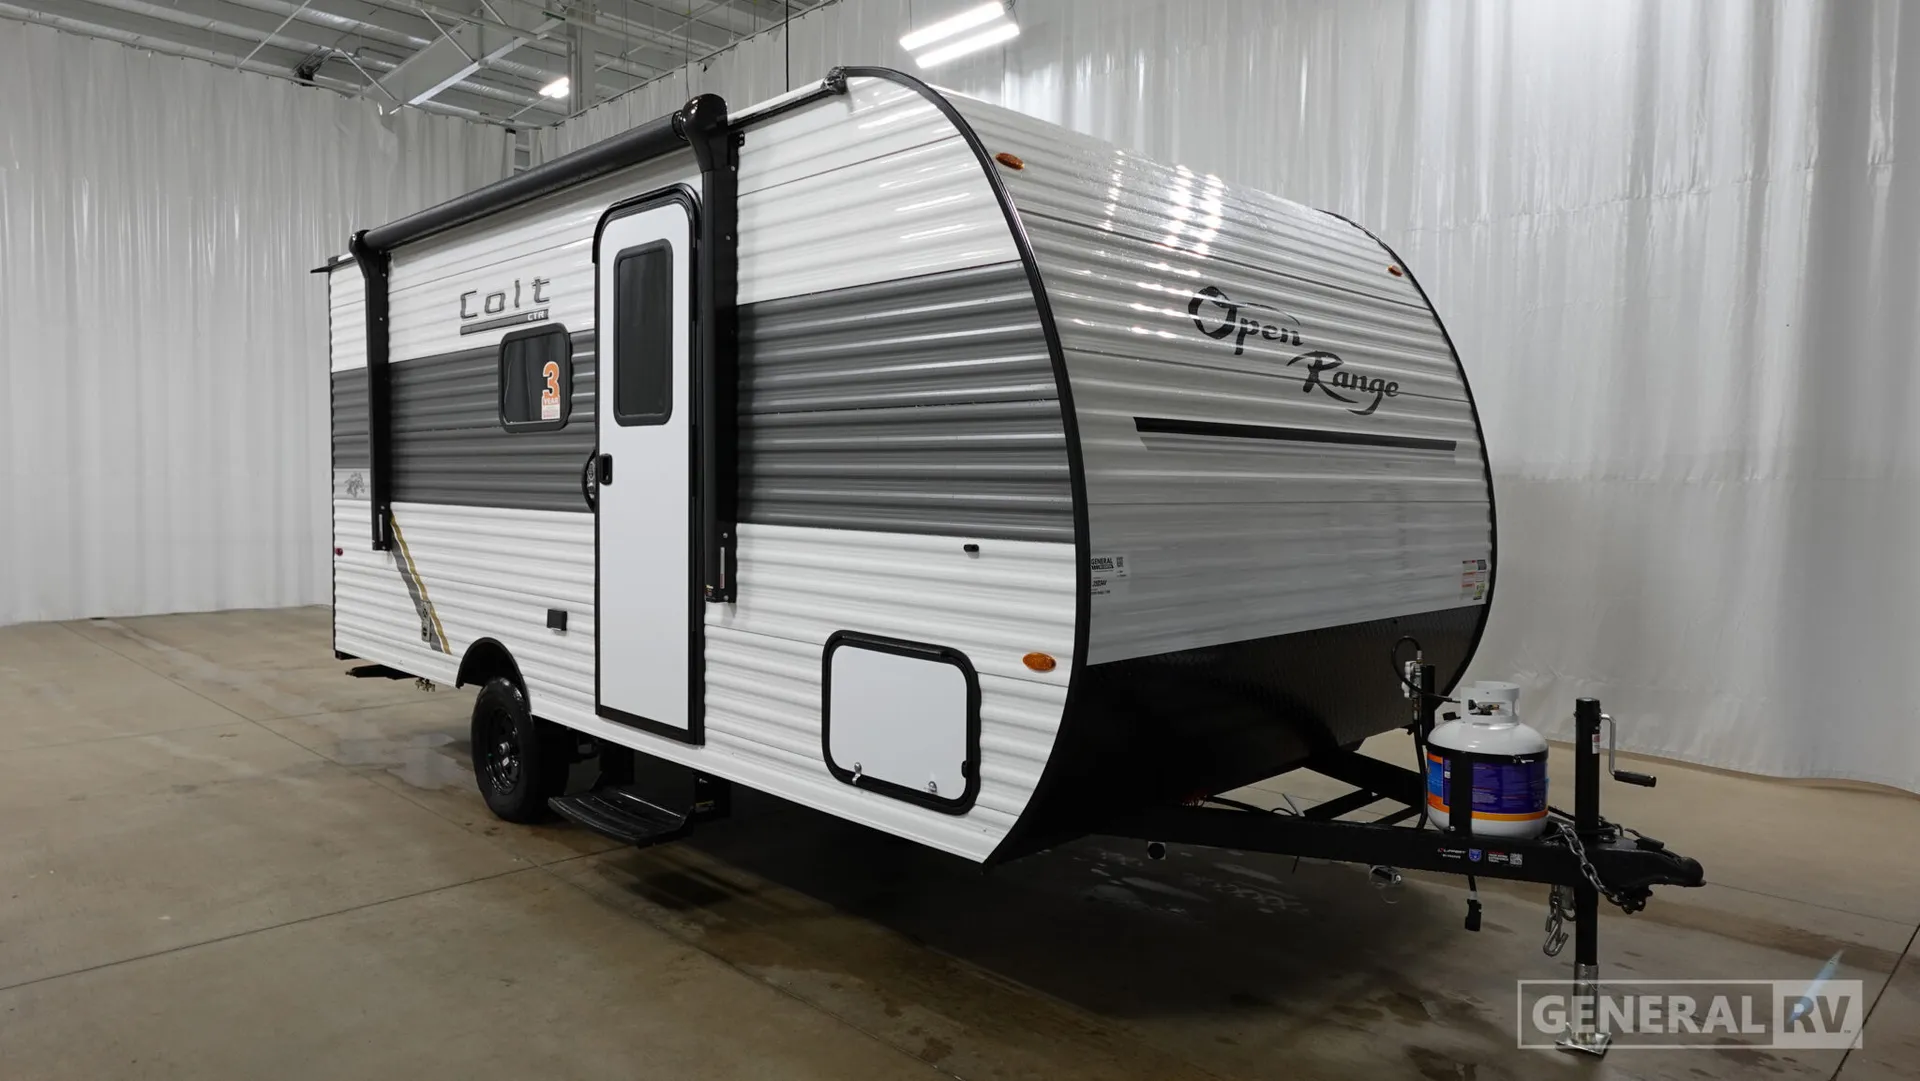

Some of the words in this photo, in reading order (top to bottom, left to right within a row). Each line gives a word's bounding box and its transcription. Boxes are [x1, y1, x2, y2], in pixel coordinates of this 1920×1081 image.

[460, 278, 550, 319] Colt
[527, 310, 545, 321] CTR
[1188, 286, 1303, 355] Open
[543, 361, 560, 398] 3
[1287, 351, 1399, 415] Range
